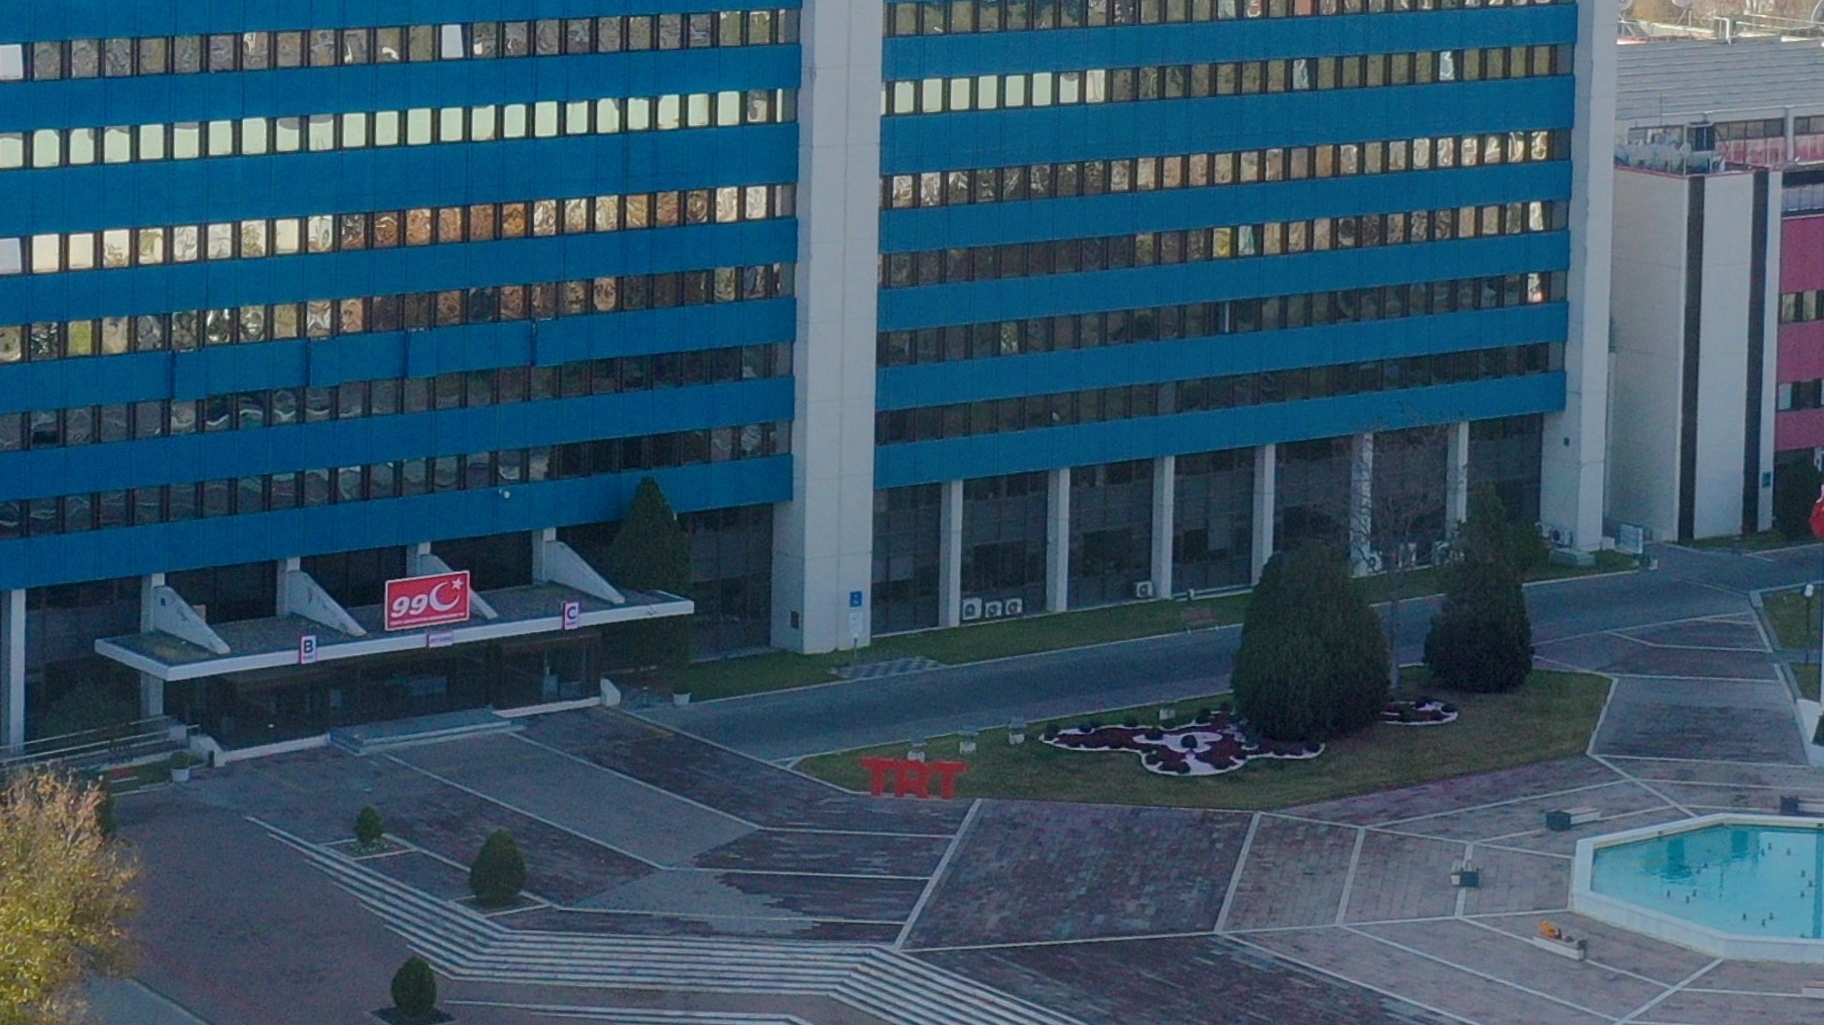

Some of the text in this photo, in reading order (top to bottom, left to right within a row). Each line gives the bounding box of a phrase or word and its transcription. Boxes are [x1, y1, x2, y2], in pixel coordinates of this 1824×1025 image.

[566, 605, 577, 620] C
[303, 639, 314, 654] B
[859, 757, 969, 800] TRT
